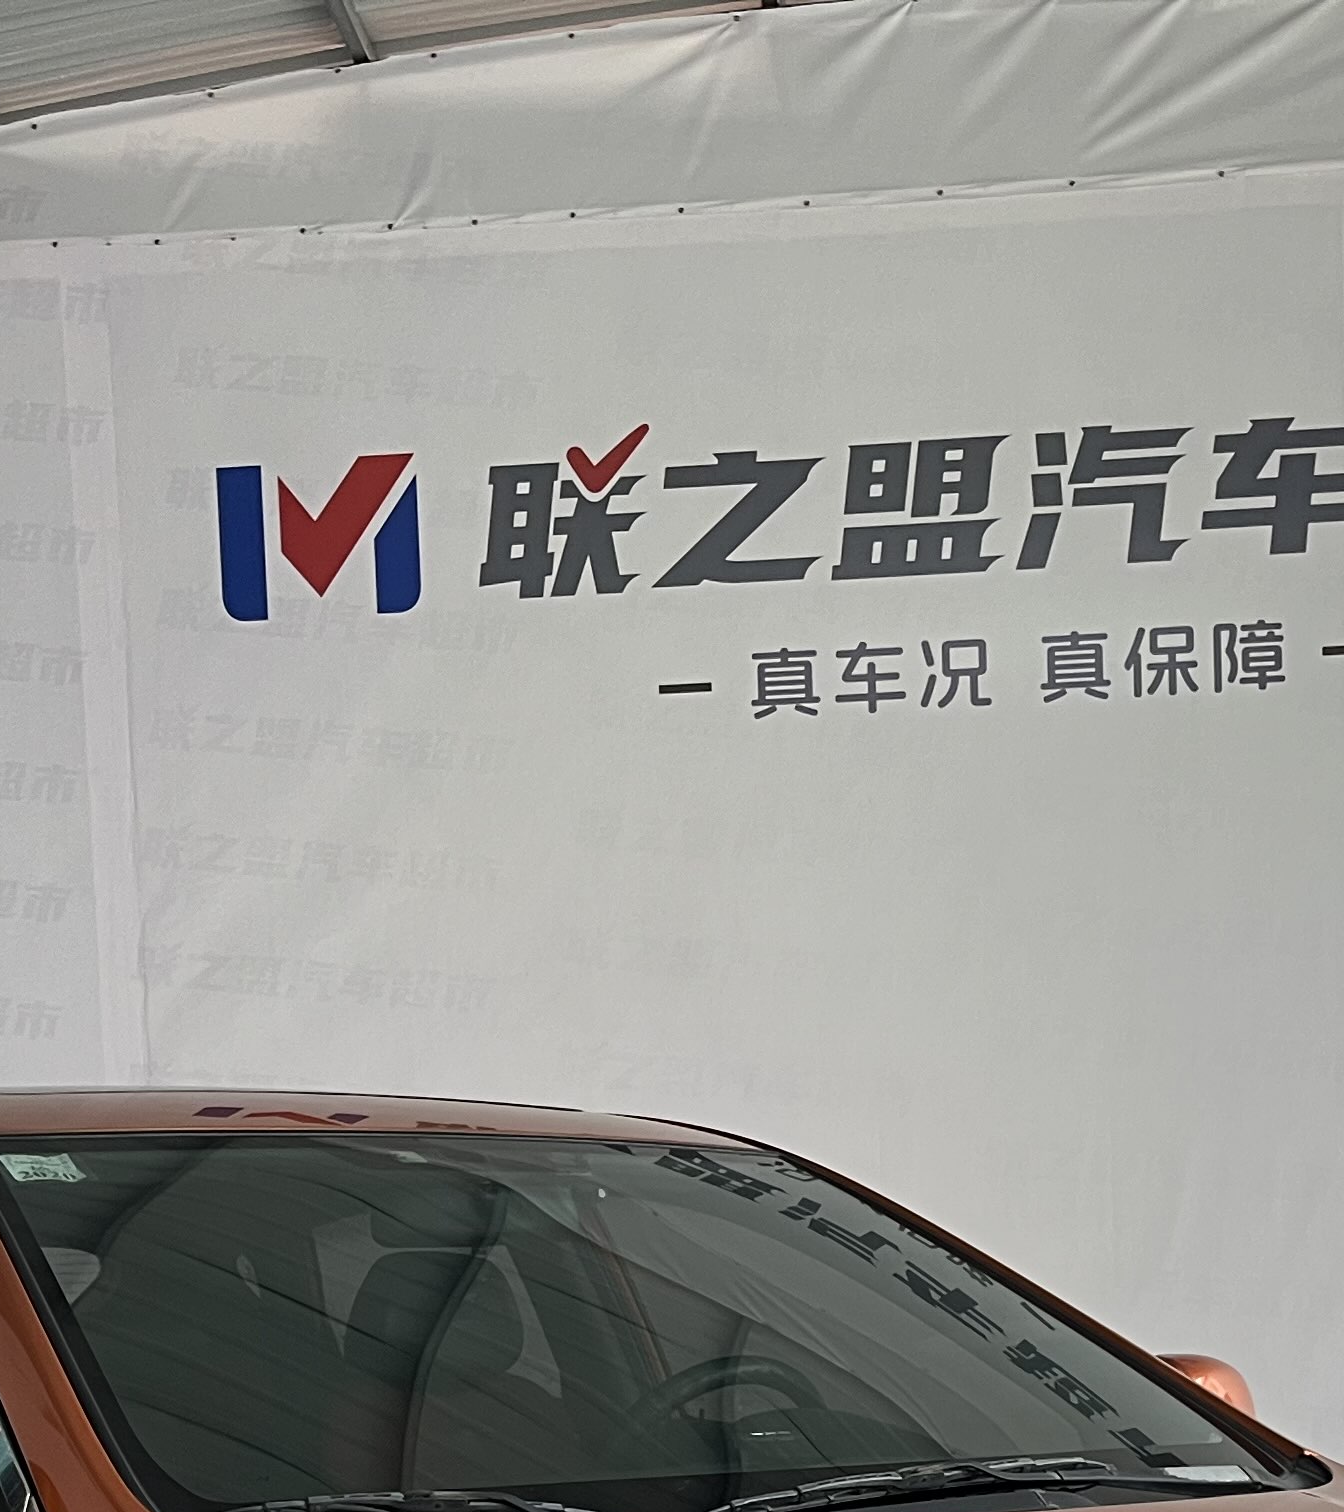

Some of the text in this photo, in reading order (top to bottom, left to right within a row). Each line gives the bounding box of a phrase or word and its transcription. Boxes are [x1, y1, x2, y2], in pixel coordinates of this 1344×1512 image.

[749, 611, 1288, 720] 真车况 真保障
